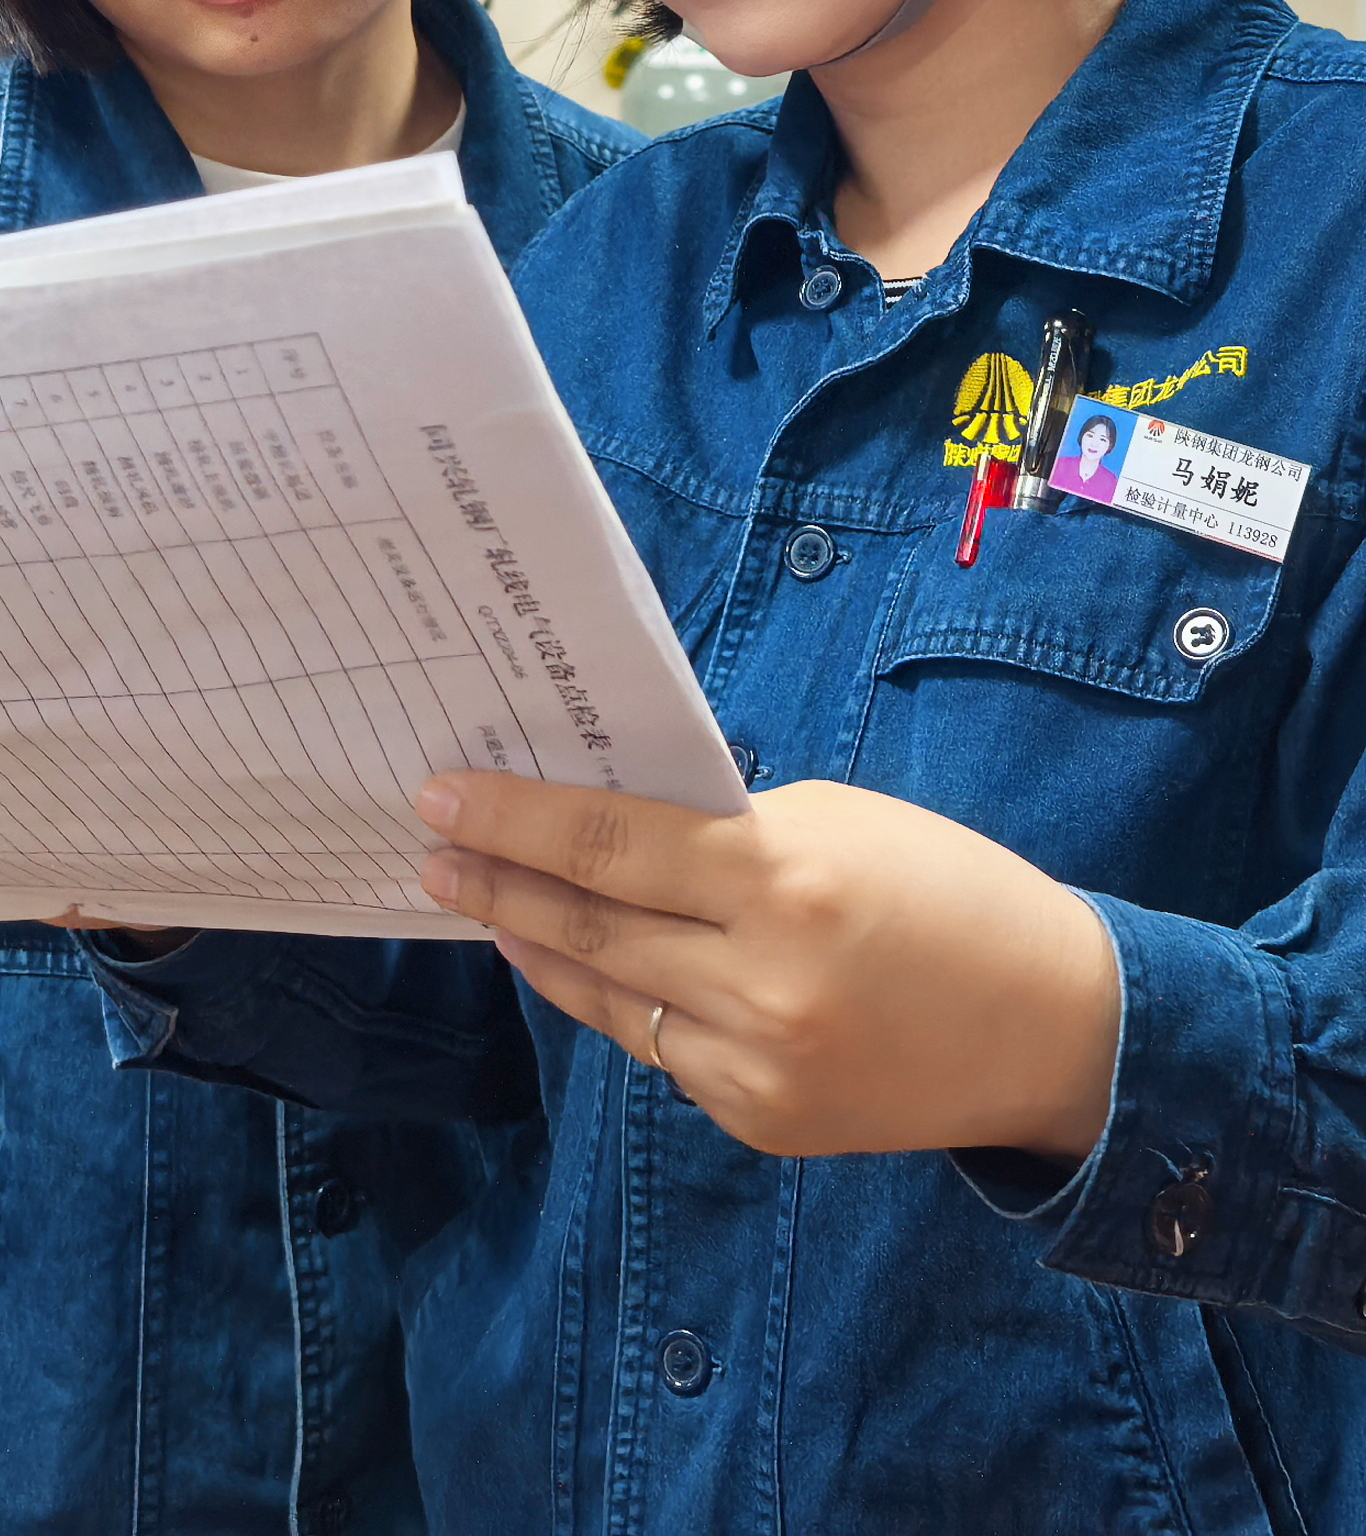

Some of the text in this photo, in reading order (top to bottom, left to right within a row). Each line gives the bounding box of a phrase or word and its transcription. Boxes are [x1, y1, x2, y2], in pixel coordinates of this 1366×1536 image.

[1171, 457, 1260, 508] 马娟妮
[1173, 427, 1304, 483] 陕钢集团龙钢公司
[1125, 486, 1279, 549] 检验计量中心 113928
